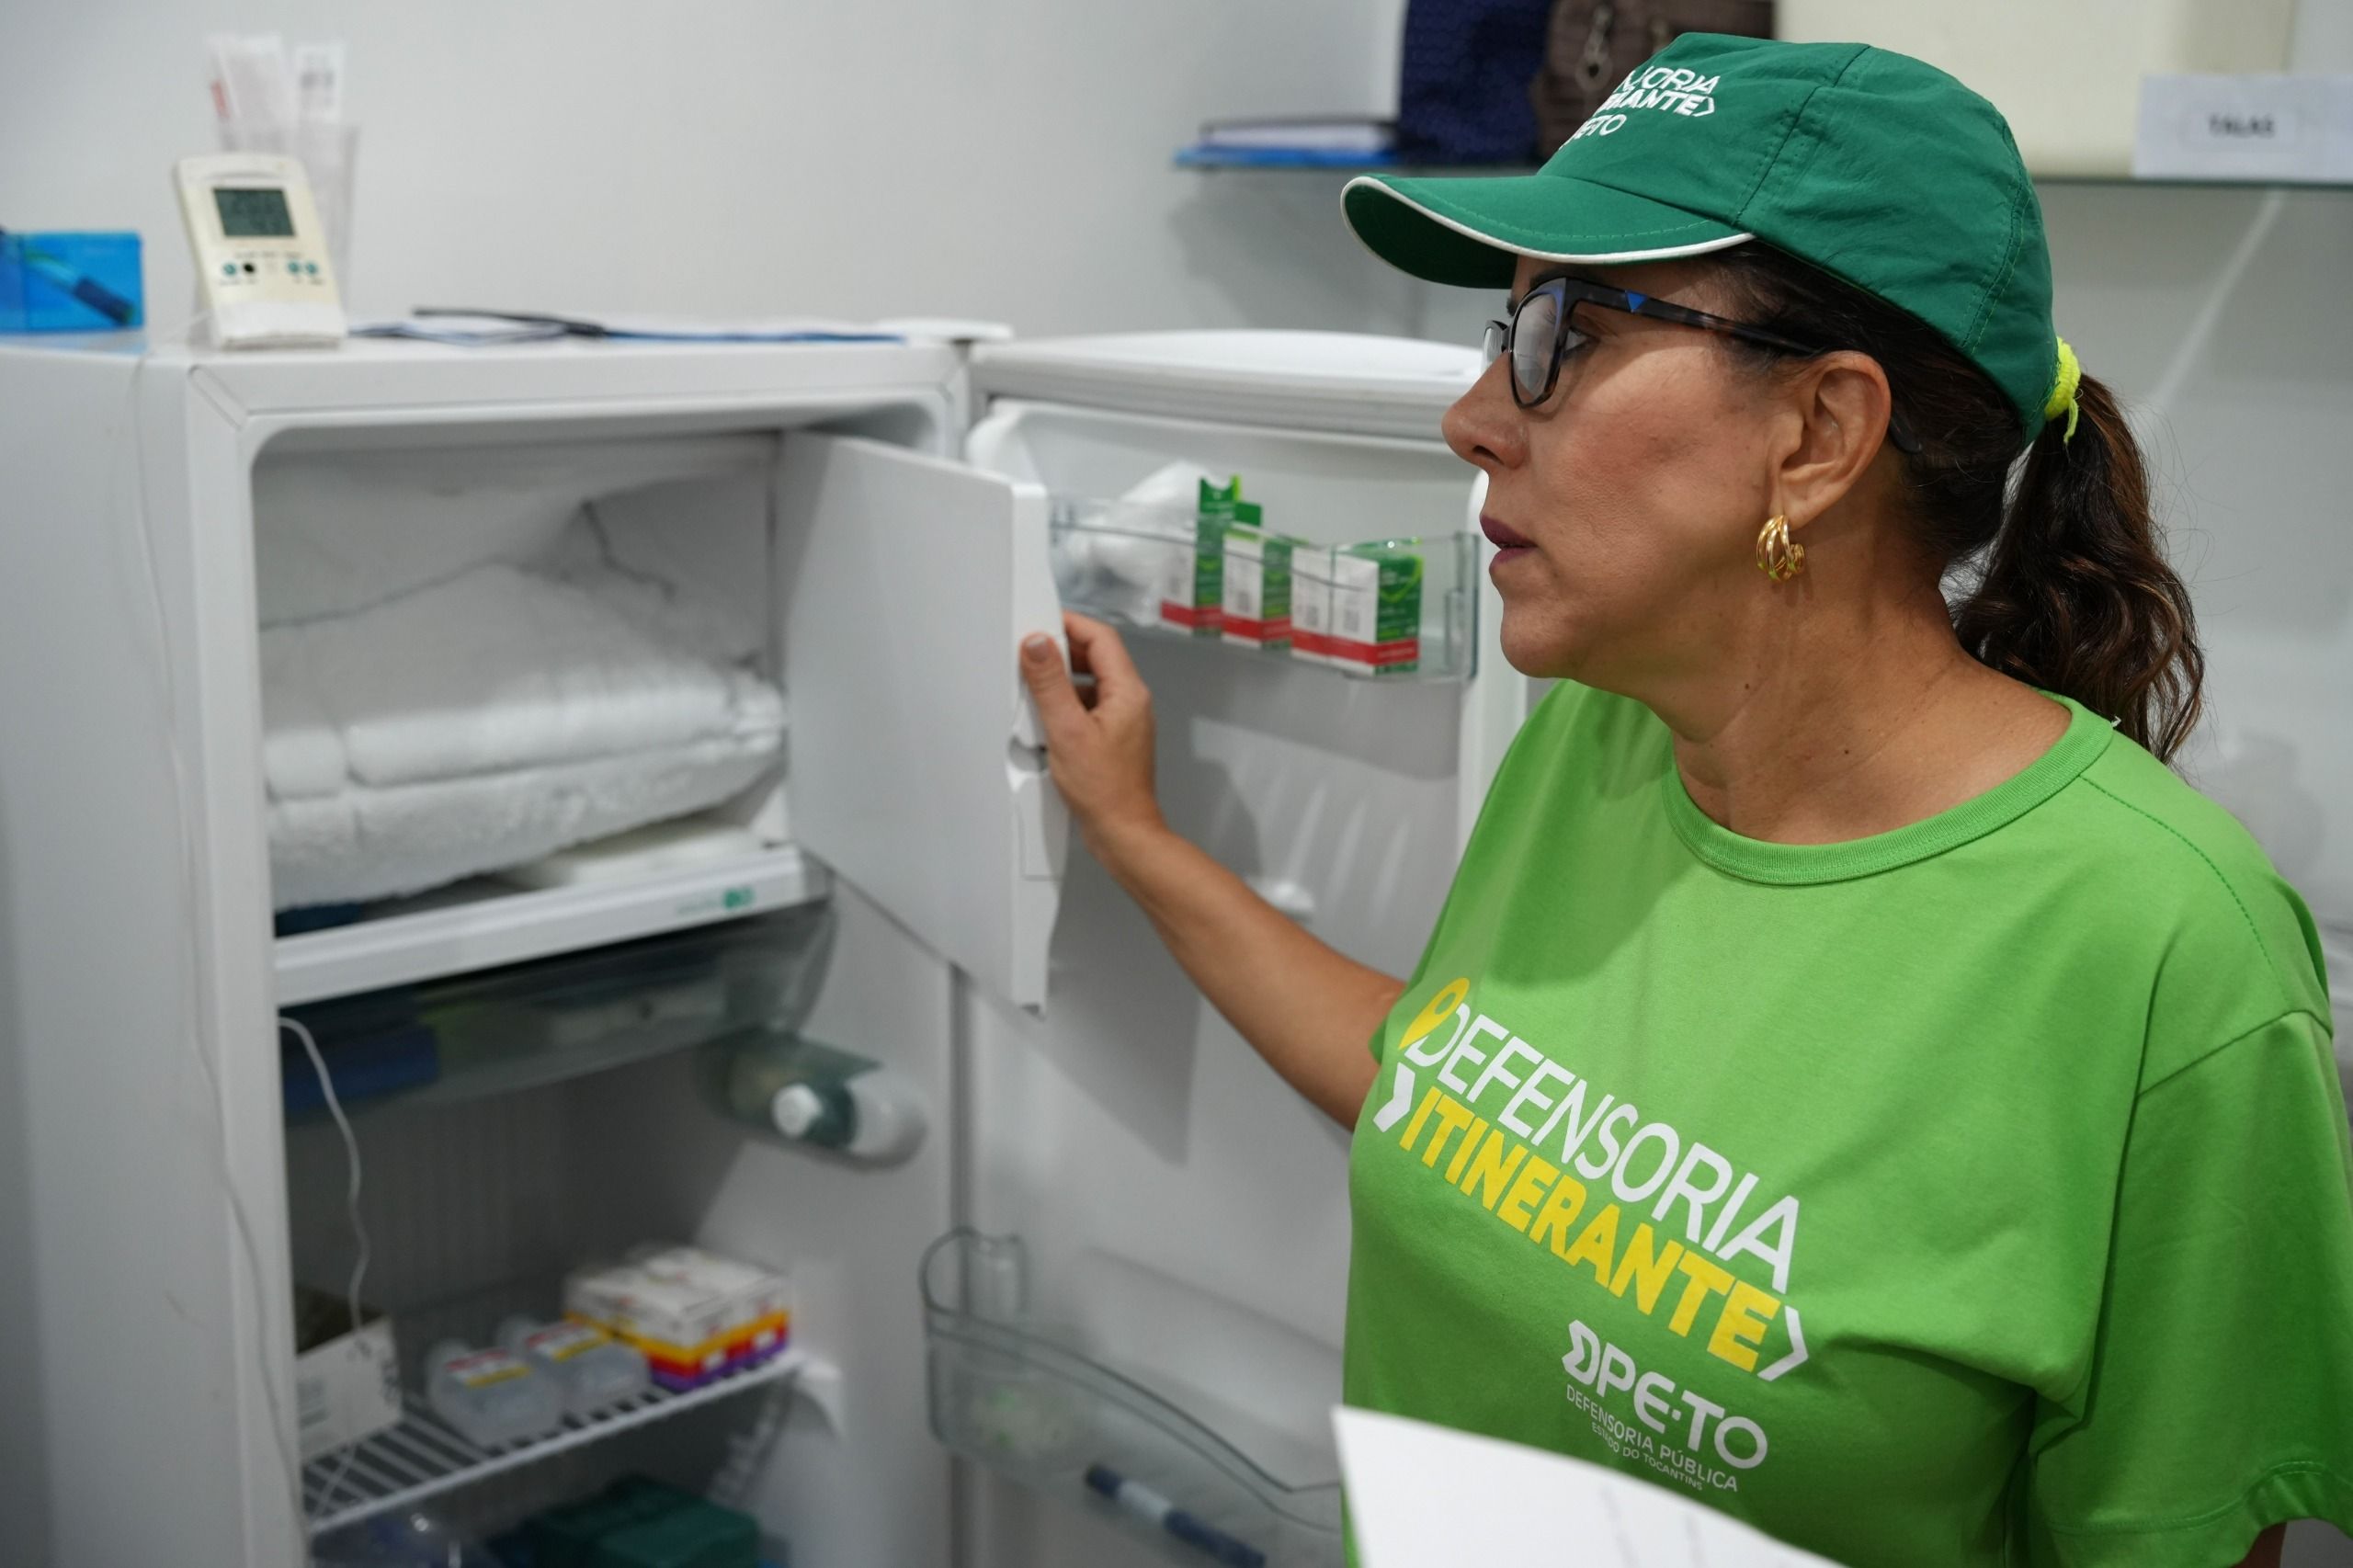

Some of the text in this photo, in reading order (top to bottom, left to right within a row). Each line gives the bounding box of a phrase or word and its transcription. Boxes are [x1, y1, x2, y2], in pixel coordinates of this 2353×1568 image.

[1398, 978, 1799, 1294] DEFENSORIA
[1399, 1086, 1781, 1372] ITINERANTE
[1566, 1383, 1737, 1492] DEFENSORIA PÚBLICA
[1592, 1422, 1703, 1491] ESTADO DO TOCANTINS
